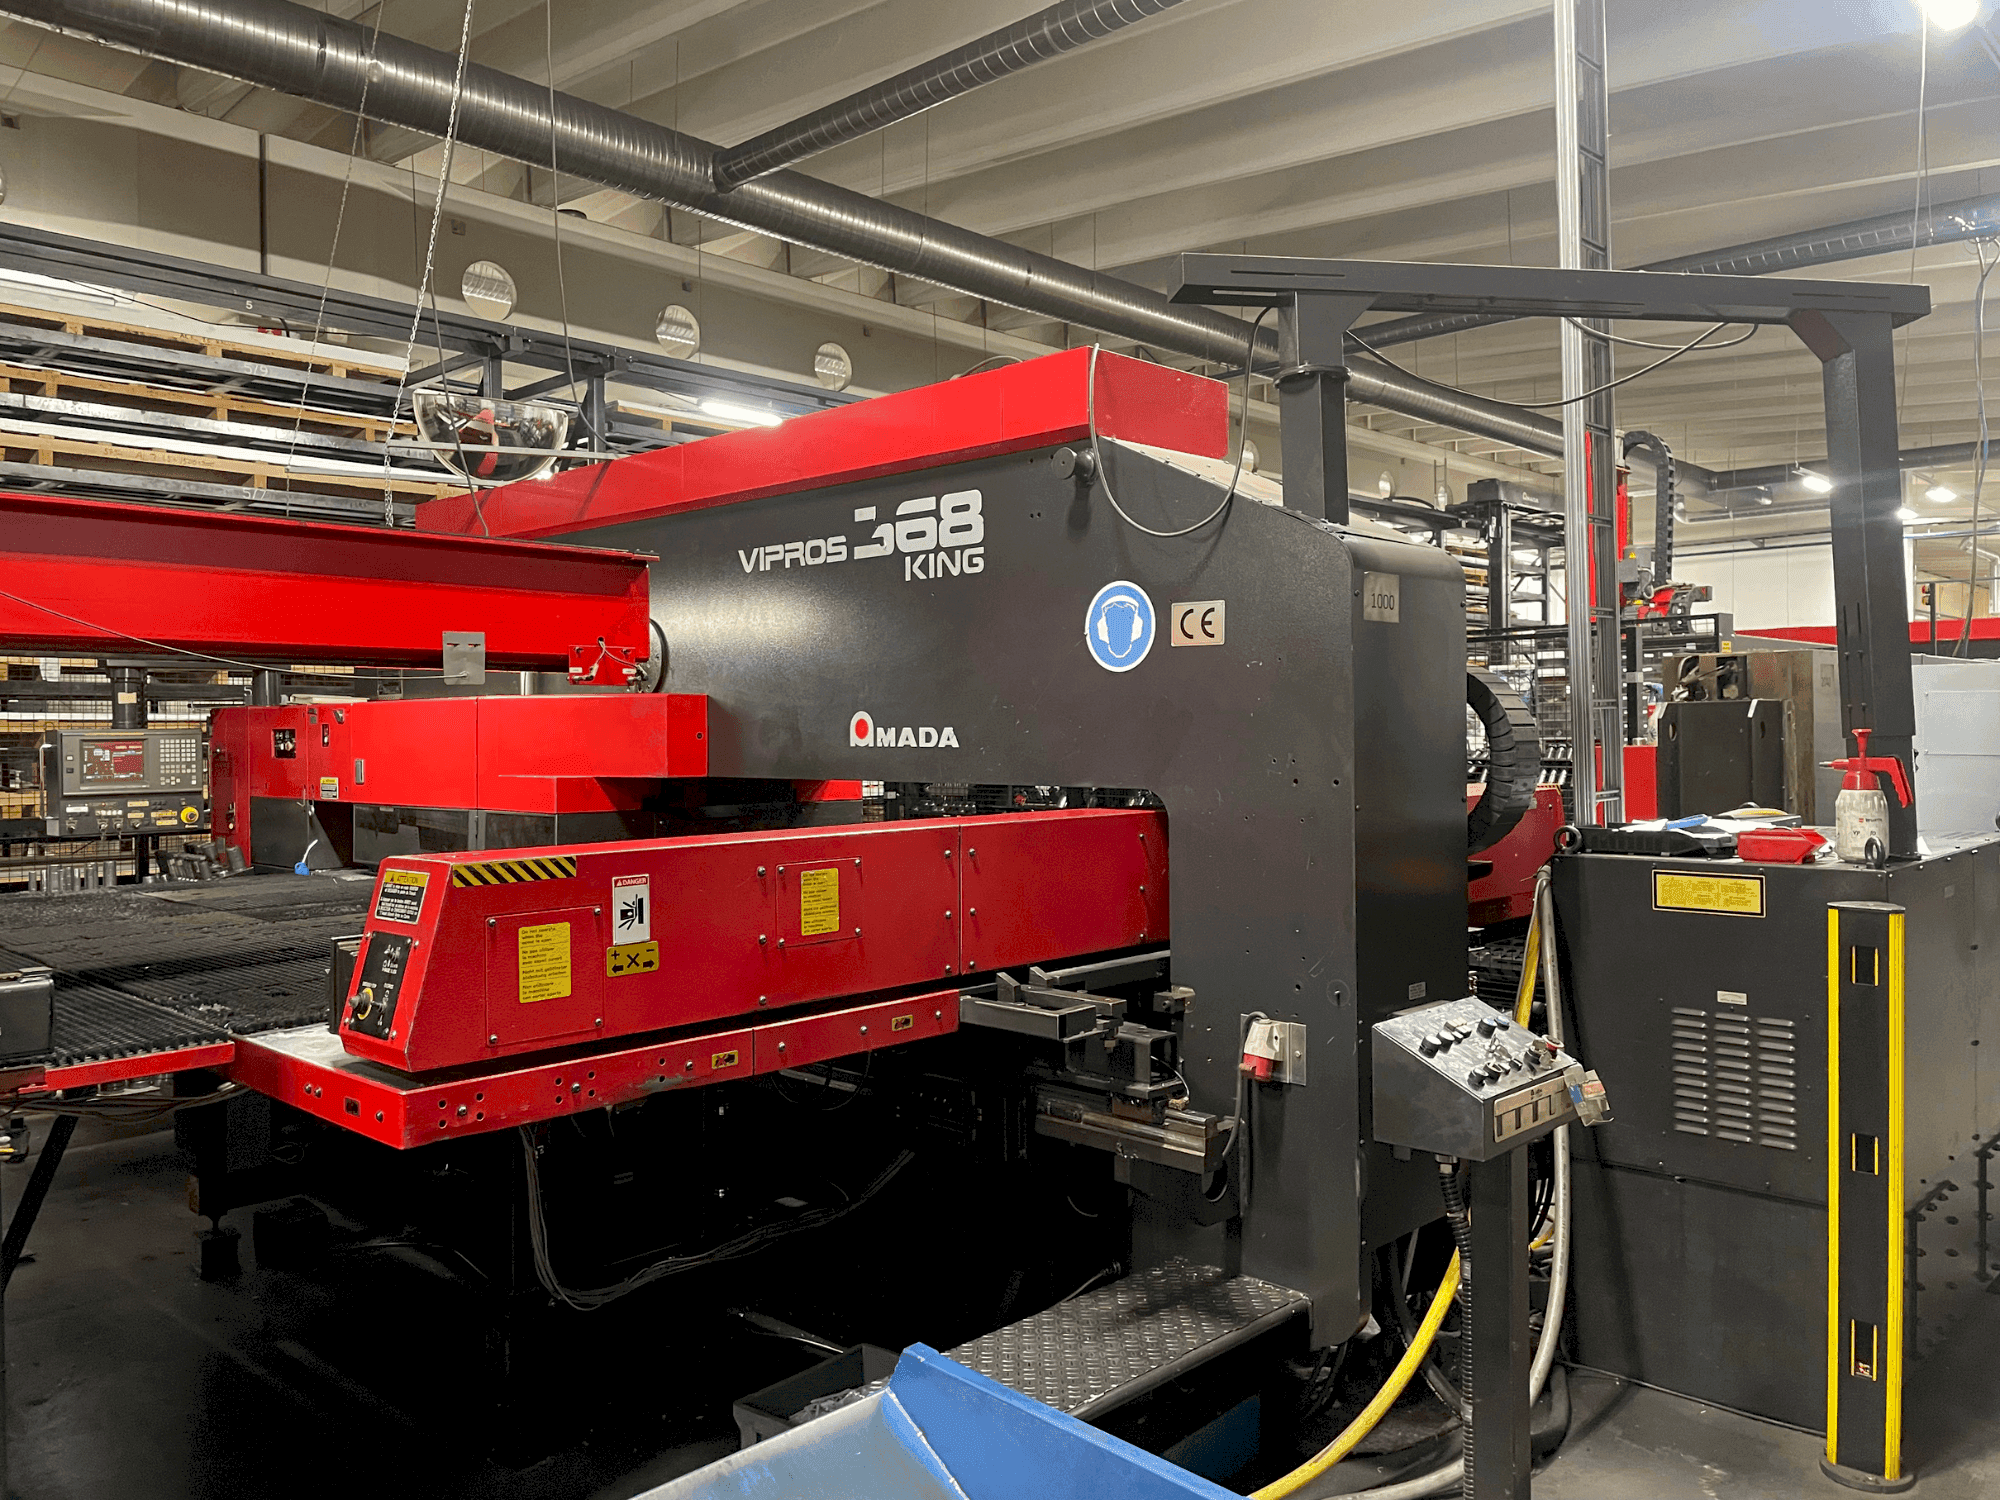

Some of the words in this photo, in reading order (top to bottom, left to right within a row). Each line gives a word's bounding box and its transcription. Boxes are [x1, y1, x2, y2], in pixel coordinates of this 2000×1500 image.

[246, 300, 253, 310] 5
[243, 362, 269, 376] 5/9
[738, 535, 848, 574] VIPROS
[853, 489, 984, 560] 368
[904, 546, 985, 581] KING
[1371, 593, 1395, 611] 1000
[1180, 607, 1215, 639] CE
[850, 710, 960, 748] AMADA
[622, 877, 647, 886] DANGER
[626, 952, 640, 969] X
